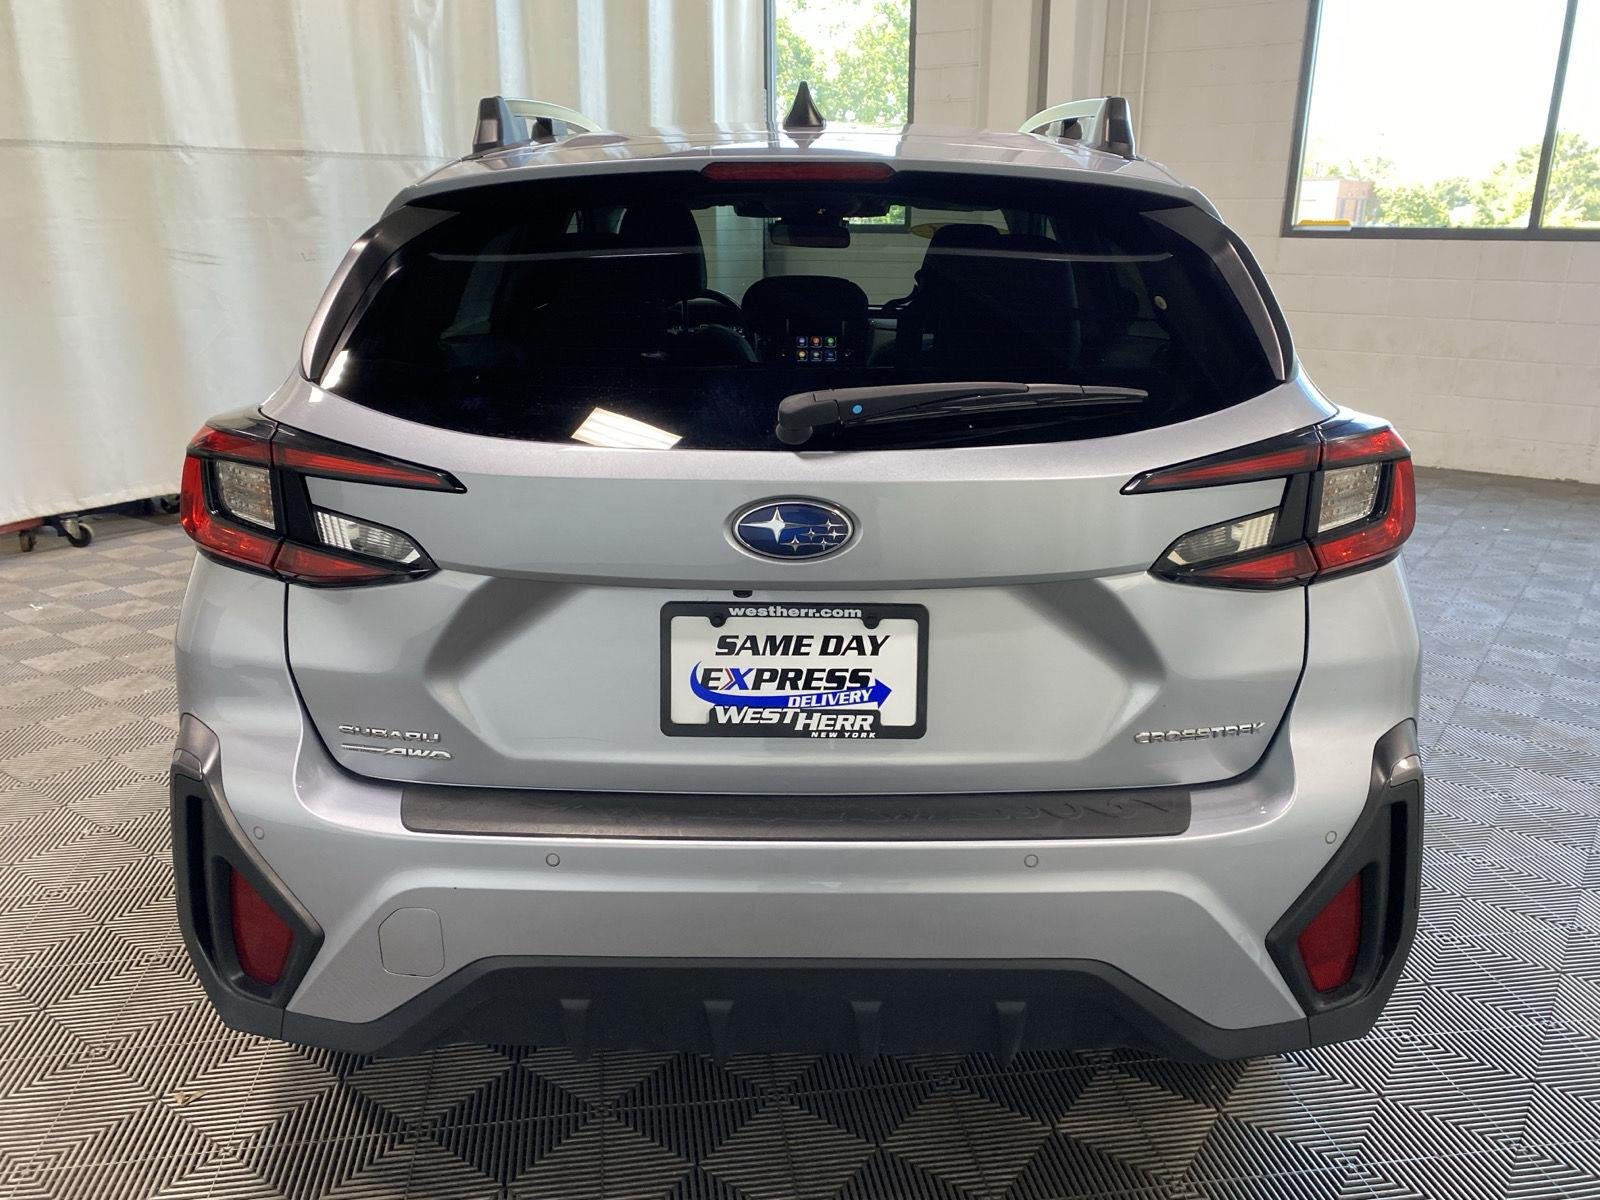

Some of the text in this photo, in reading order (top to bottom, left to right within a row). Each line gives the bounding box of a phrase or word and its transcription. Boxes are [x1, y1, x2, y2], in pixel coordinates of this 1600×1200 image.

[715, 635, 890, 656] SAME DAY
[701, 668, 872, 690] EXPRESS
[787, 689, 873, 708] DELIVERY
[339, 725, 441, 742] SUBARU
[811, 731, 838, 739] NEW
[1134, 722, 1265, 743] CROSSTREK
